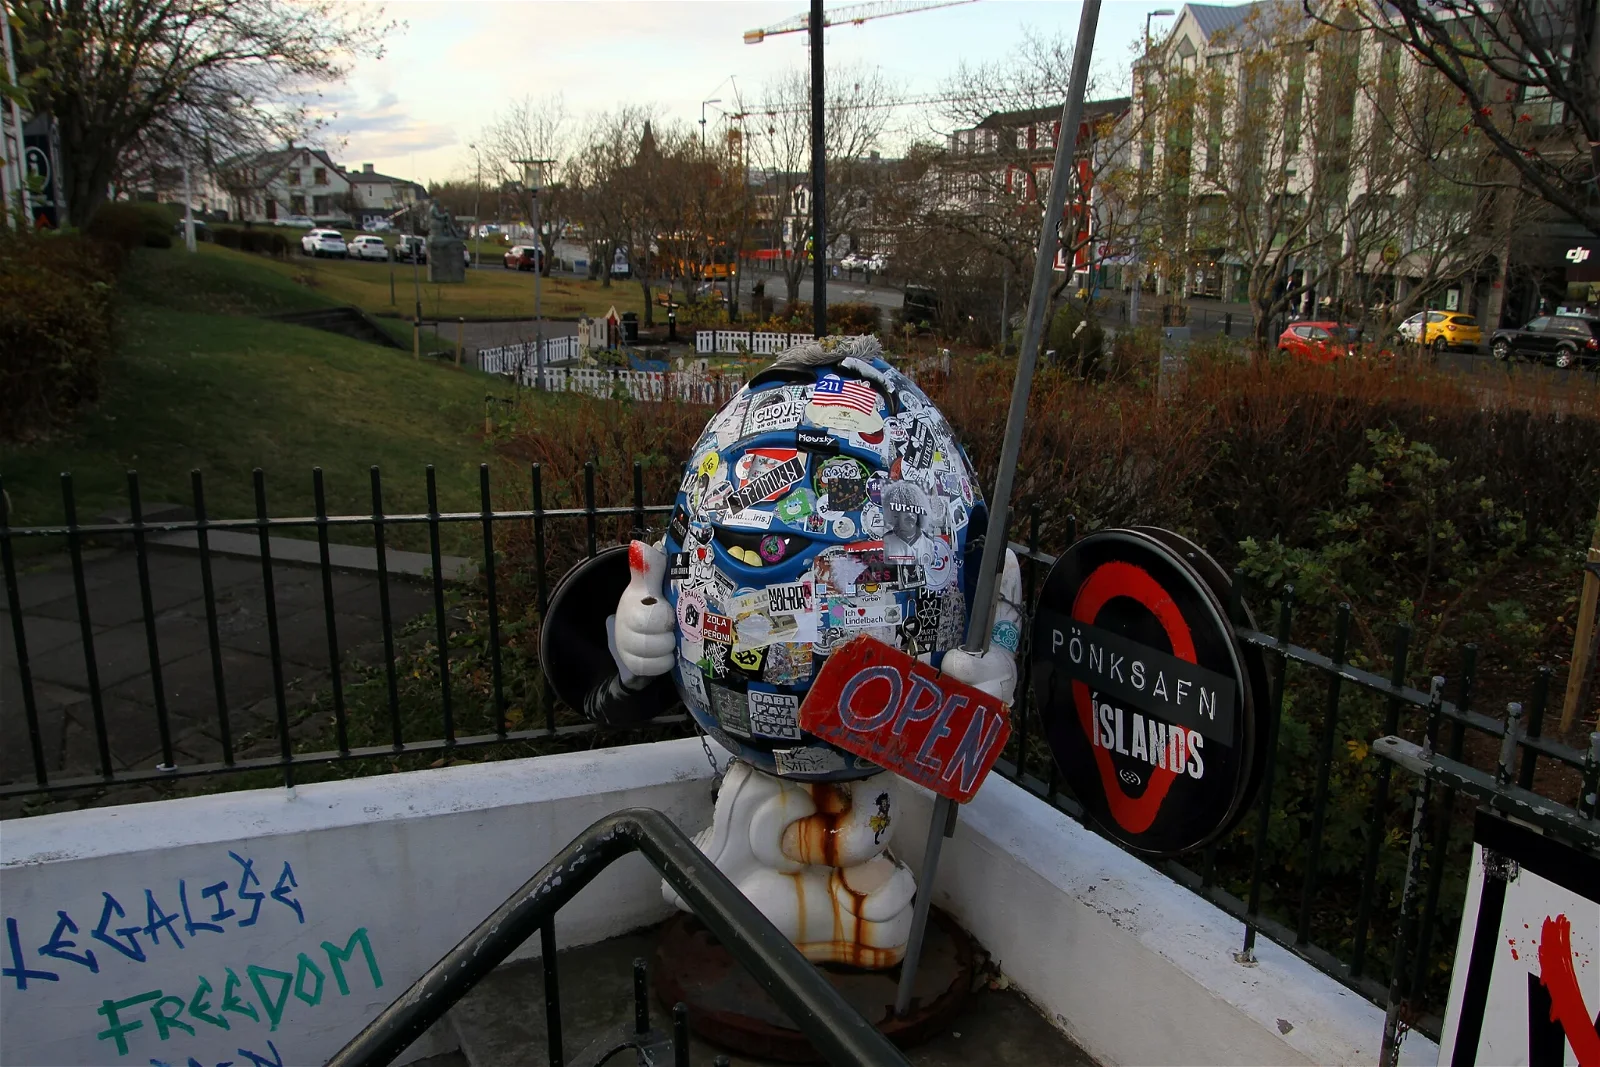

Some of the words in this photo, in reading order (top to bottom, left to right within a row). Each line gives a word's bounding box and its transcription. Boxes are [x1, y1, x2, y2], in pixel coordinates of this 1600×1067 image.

[1566, 246, 1590, 263] dji
[816, 380, 840, 391] 211
[754, 400, 804, 423] CLOVIS
[767, 584, 812, 601] MALDITA
[706, 614, 727, 627] ZOLA
[845, 609, 856, 617] Ich
[845, 615, 883, 625] Lindelbach
[703, 628, 730, 642] PERONI
[1052, 626, 1216, 720] PÖNKSAFN
[838, 665, 1003, 793] OPEN
[1091, 691, 1204, 780] ÍSLANDS
[2, 850, 305, 990] LEGALISE
[97, 927, 384, 1055] FREEDOM
